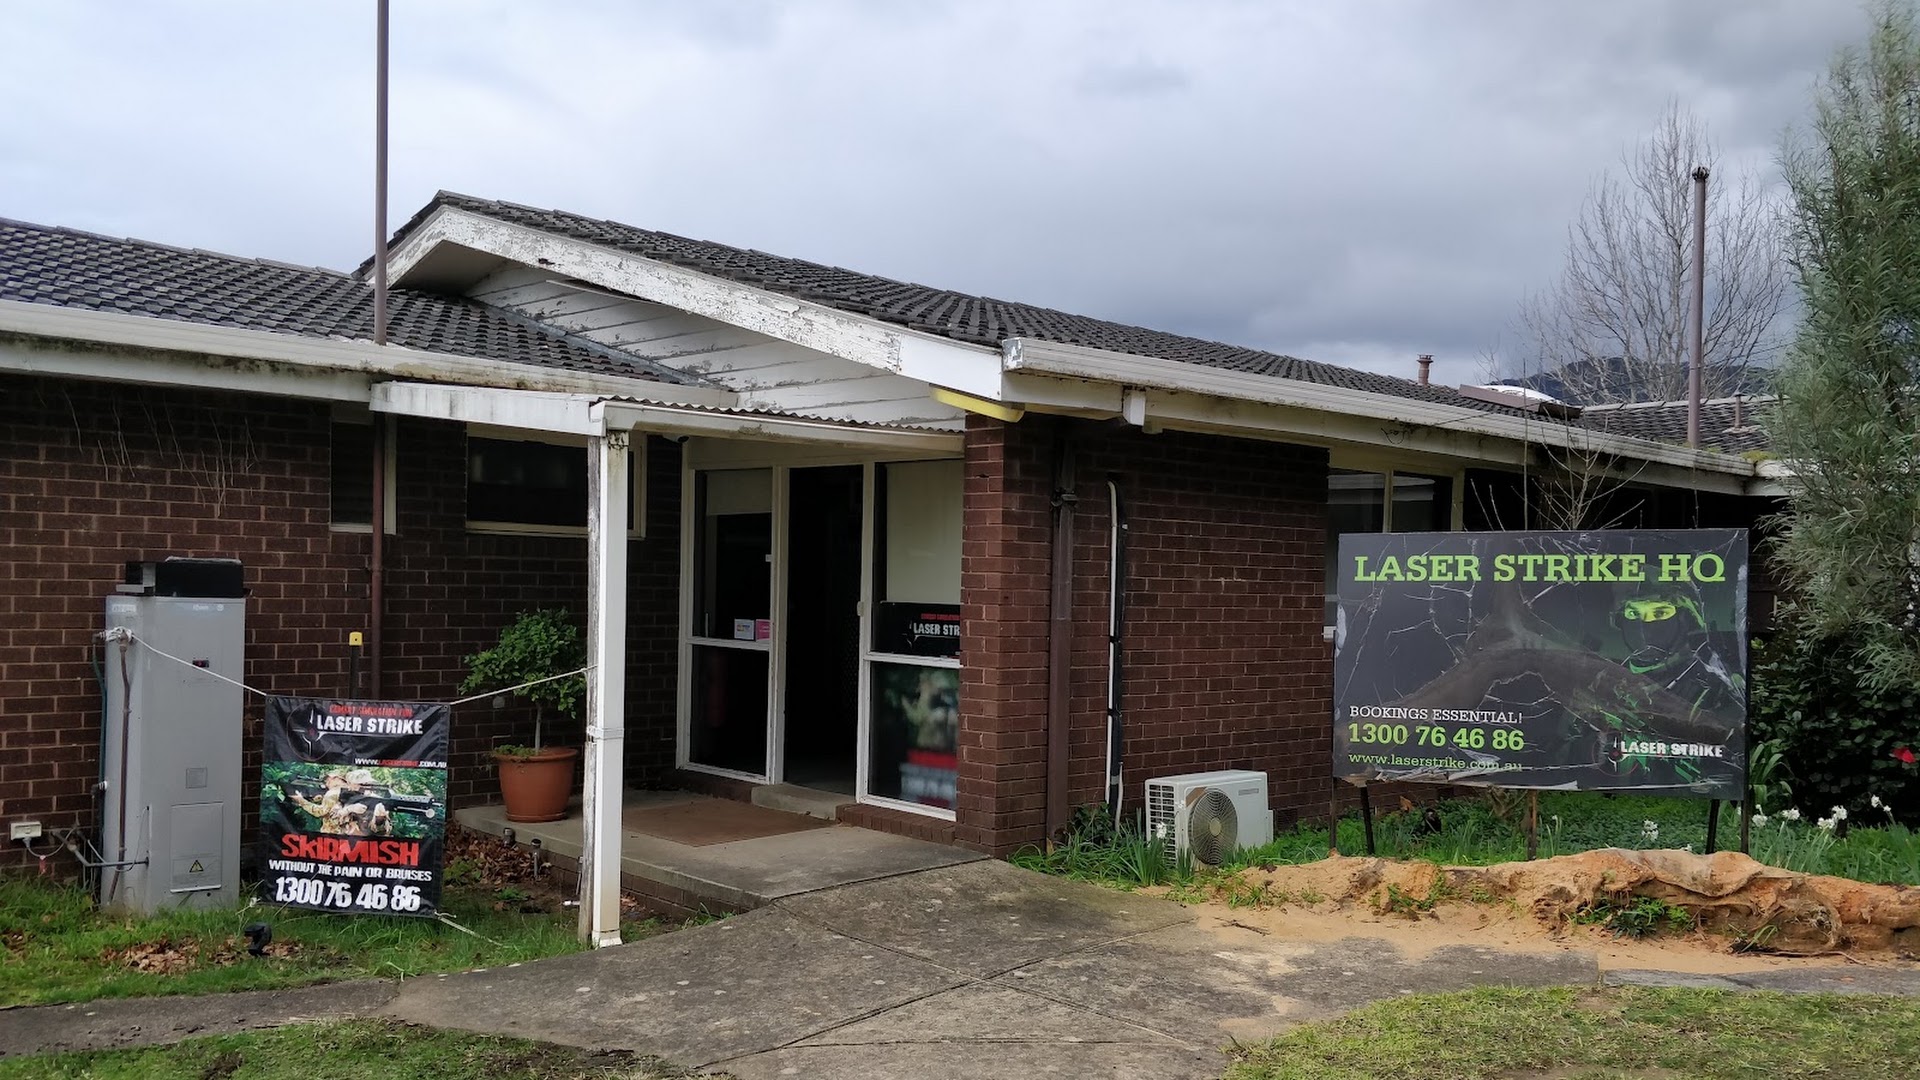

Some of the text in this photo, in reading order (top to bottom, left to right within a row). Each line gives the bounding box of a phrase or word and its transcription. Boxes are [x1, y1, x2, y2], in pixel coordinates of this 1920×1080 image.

[1354, 553, 1726, 582] LASER STRIKE HQ
[913, 622, 941, 635] LASER
[316, 714, 424, 735] LASER STRIKE
[1349, 705, 1523, 724] BOOKINGS ESSENTIAL!
[1348, 723, 1525, 751] 1300 76 46 86
[1620, 741, 1723, 758] LASER STRIKE
[1348, 752, 1523, 772] www.laserstrike.com.au
[268, 859, 433, 882] WITHOUT THE PAIN OR BRUISES
[275, 876, 421, 912] 1300 76 46 86
